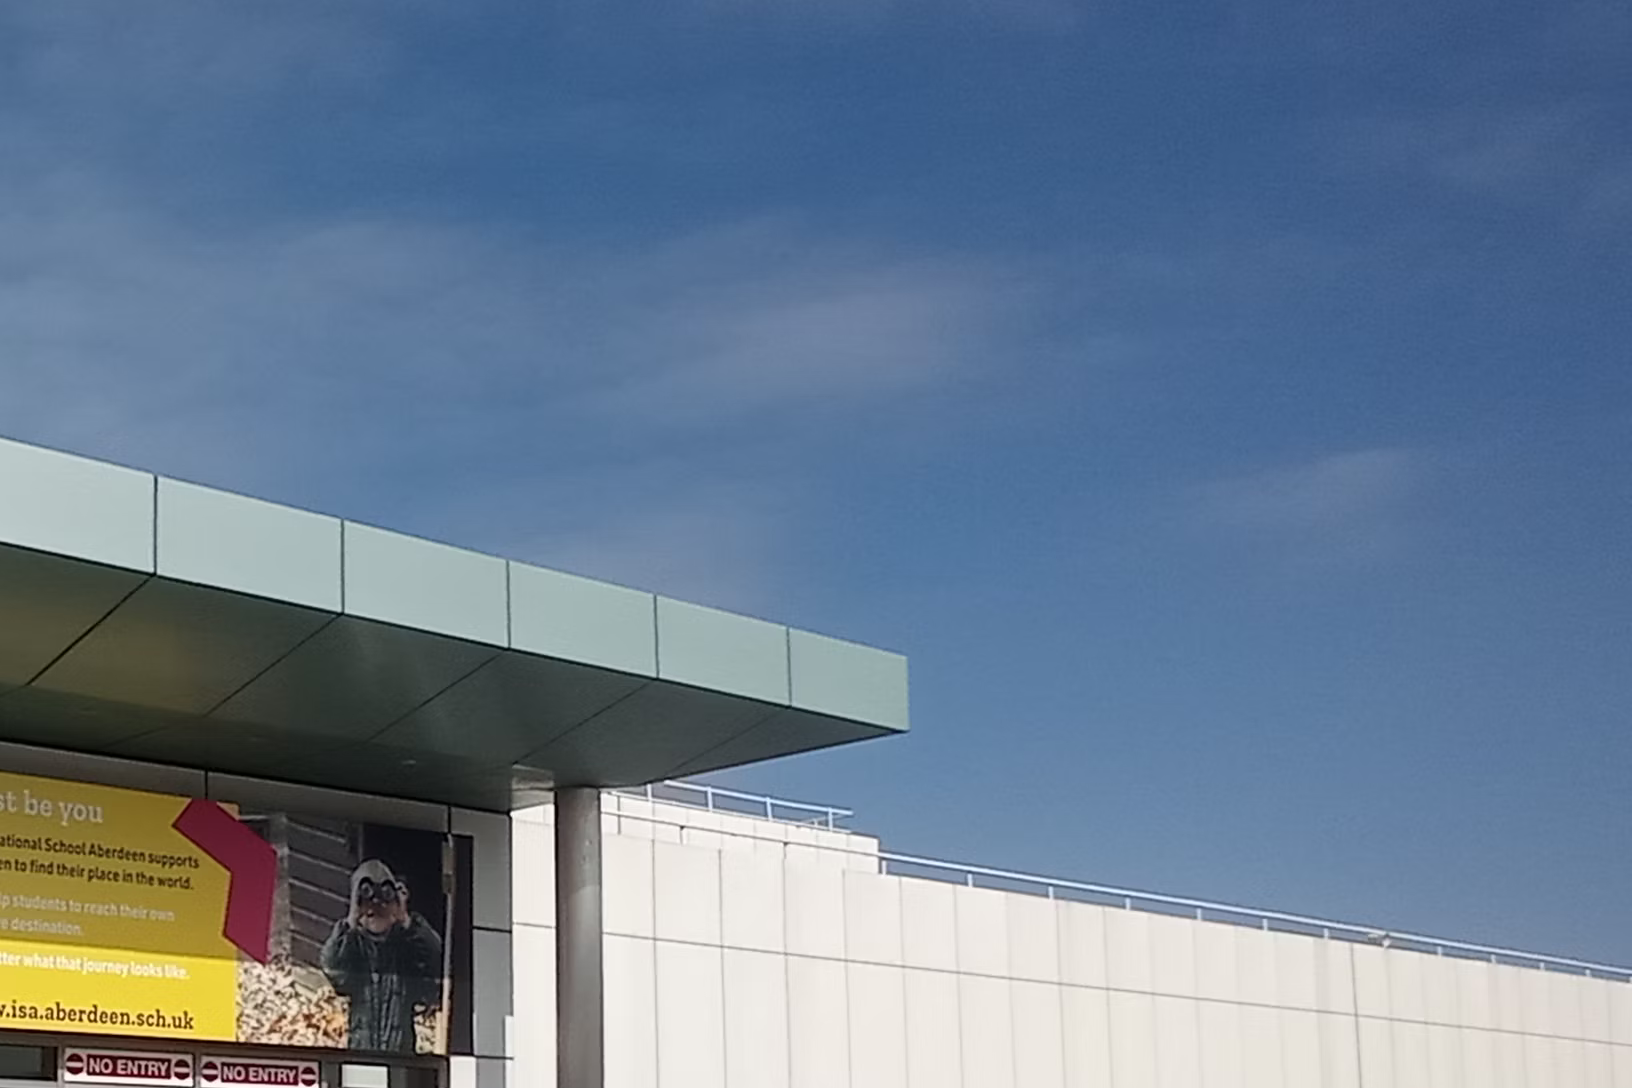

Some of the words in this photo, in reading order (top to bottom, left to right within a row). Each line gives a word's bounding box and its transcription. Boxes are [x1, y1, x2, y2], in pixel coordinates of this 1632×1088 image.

[24, 789, 53, 817] be
[58, 801, 104, 826] you
[45, 836, 87, 857] School
[88, 843, 146, 864] Aberdeen
[148, 851, 200, 870] supports
[14, 858, 27, 873] to
[29, 859, 54, 876] find
[56, 863, 84, 878] their
[87, 866, 120, 883] place
[122, 869, 134, 883] in
[135, 871, 155, 886] the
[157, 874, 195, 890] world.
[12, 894, 67, 912] students
[69, 898, 82, 914] to
[84, 900, 117, 917] reach
[119, 903, 149, 920] their
[149, 908, 175, 922] own
[11, 916, 84, 936] destination.
[23, 952, 55, 970] what
[55, 954, 81, 971] that
[82, 958, 128, 978] journey
[131, 960, 164, 978] looks
[164, 963, 191, 980] like.
[88, 1057, 113, 1075] NO
[116, 1059, 169, 1077] ENTRY
[222, 1065, 246, 1081] NO
[248, 1067, 297, 1084] ENTRY
